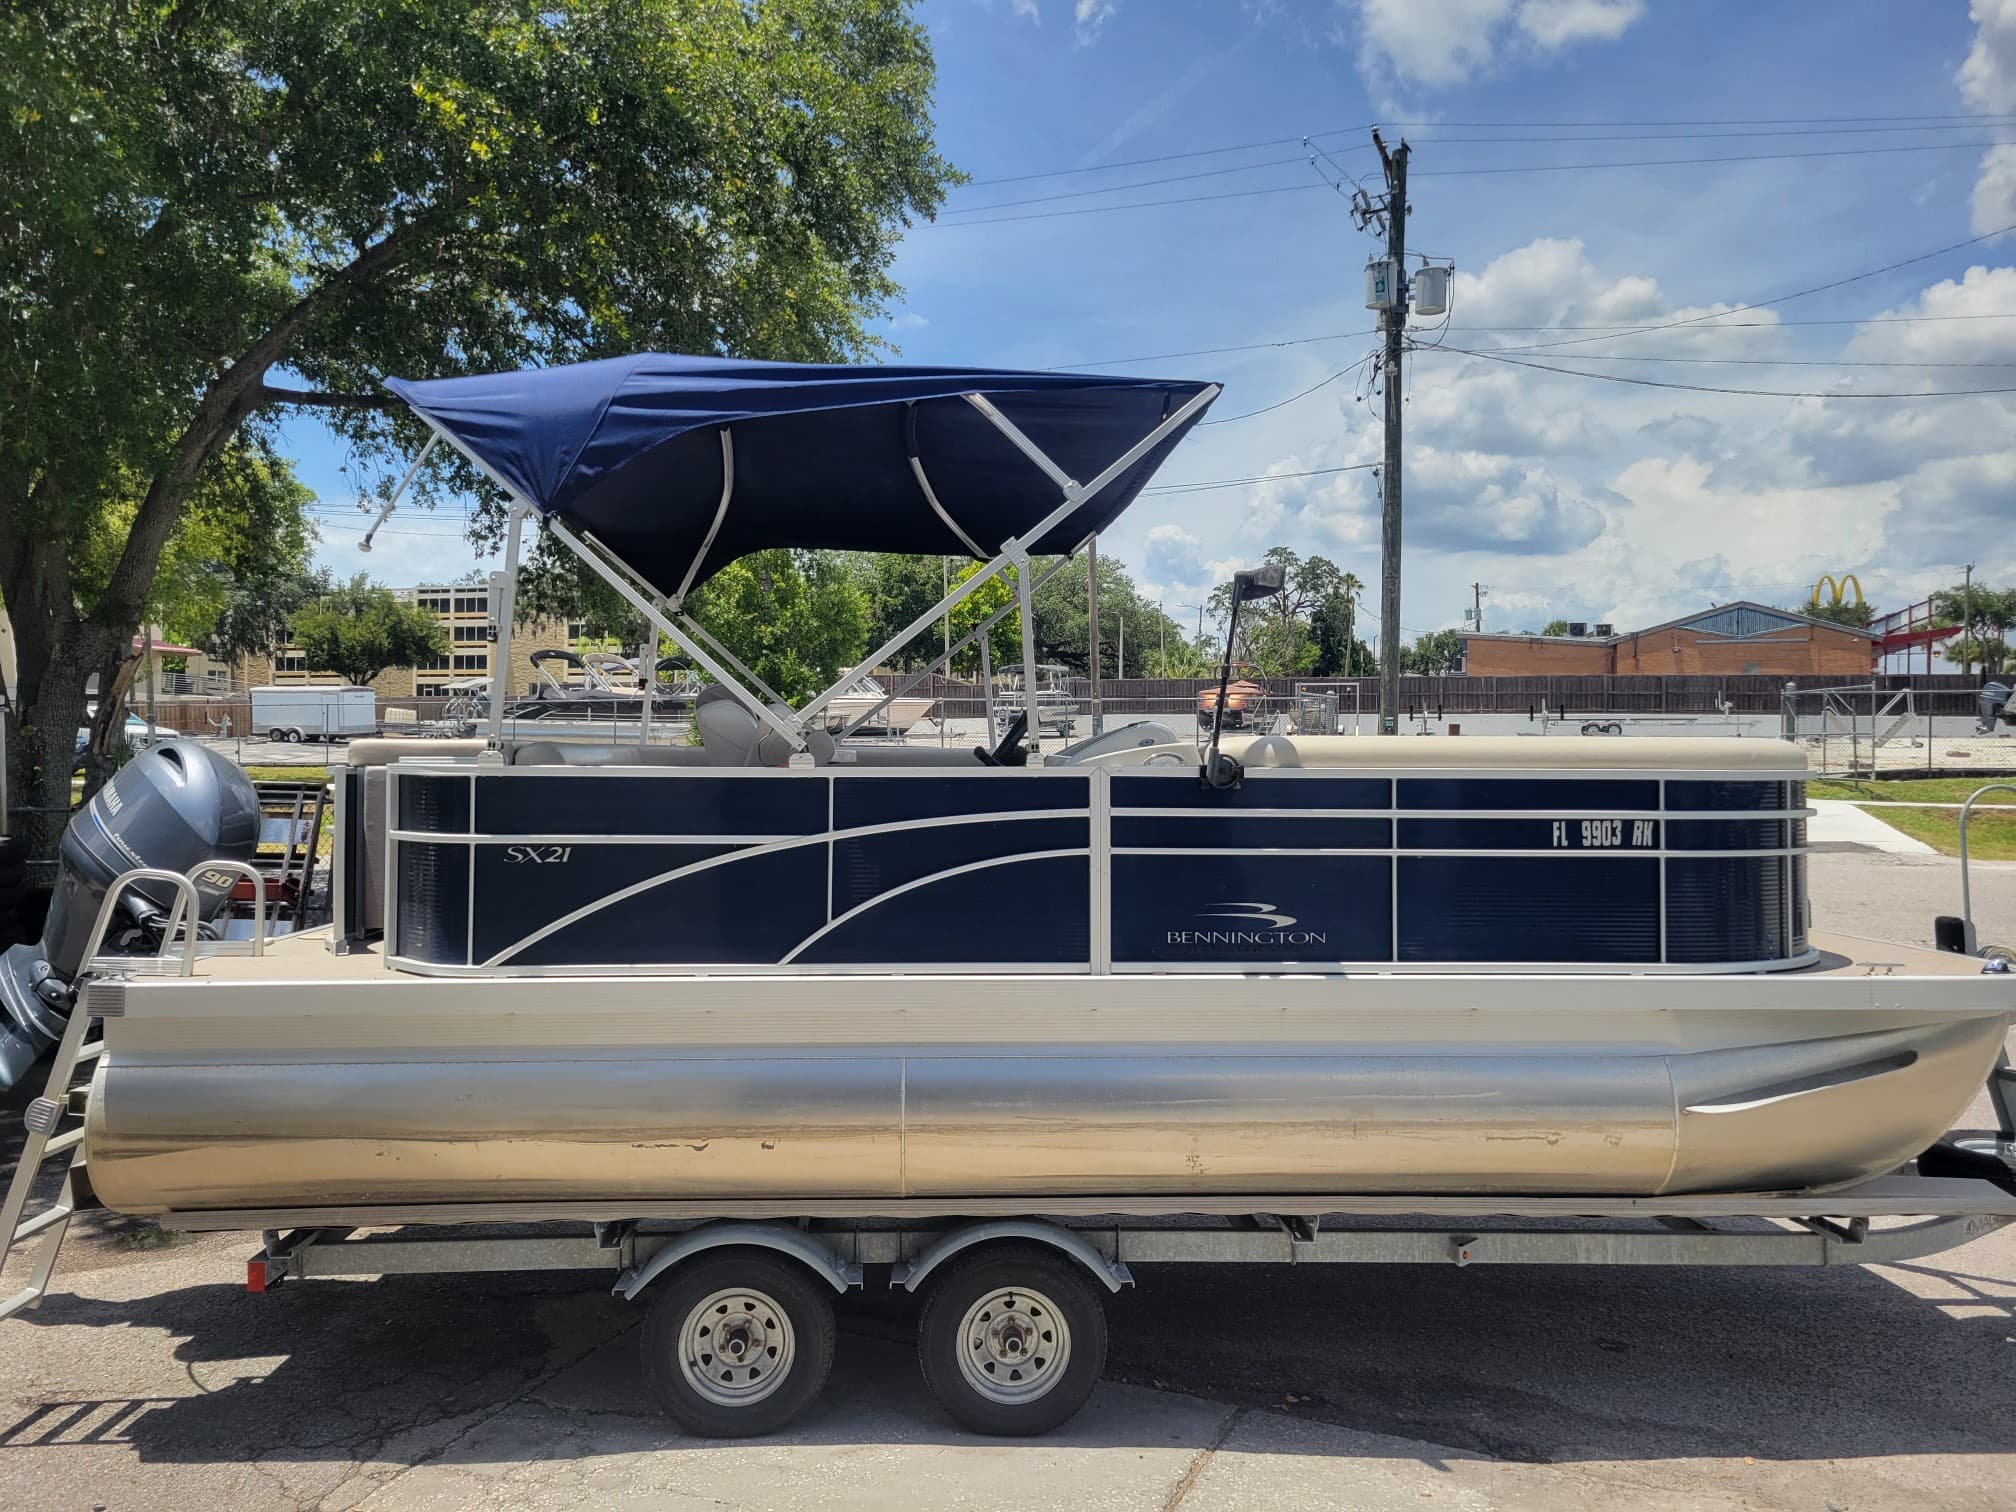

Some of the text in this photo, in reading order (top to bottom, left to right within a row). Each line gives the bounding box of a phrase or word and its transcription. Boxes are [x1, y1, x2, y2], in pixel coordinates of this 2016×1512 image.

[102, 778, 123, 816] AMAHA
[1553, 820, 1653, 847] FL 9903 RK
[503, 846, 572, 863] SX21
[202, 871, 233, 888] 90
[1167, 931, 1326, 944] BENNINGTON
